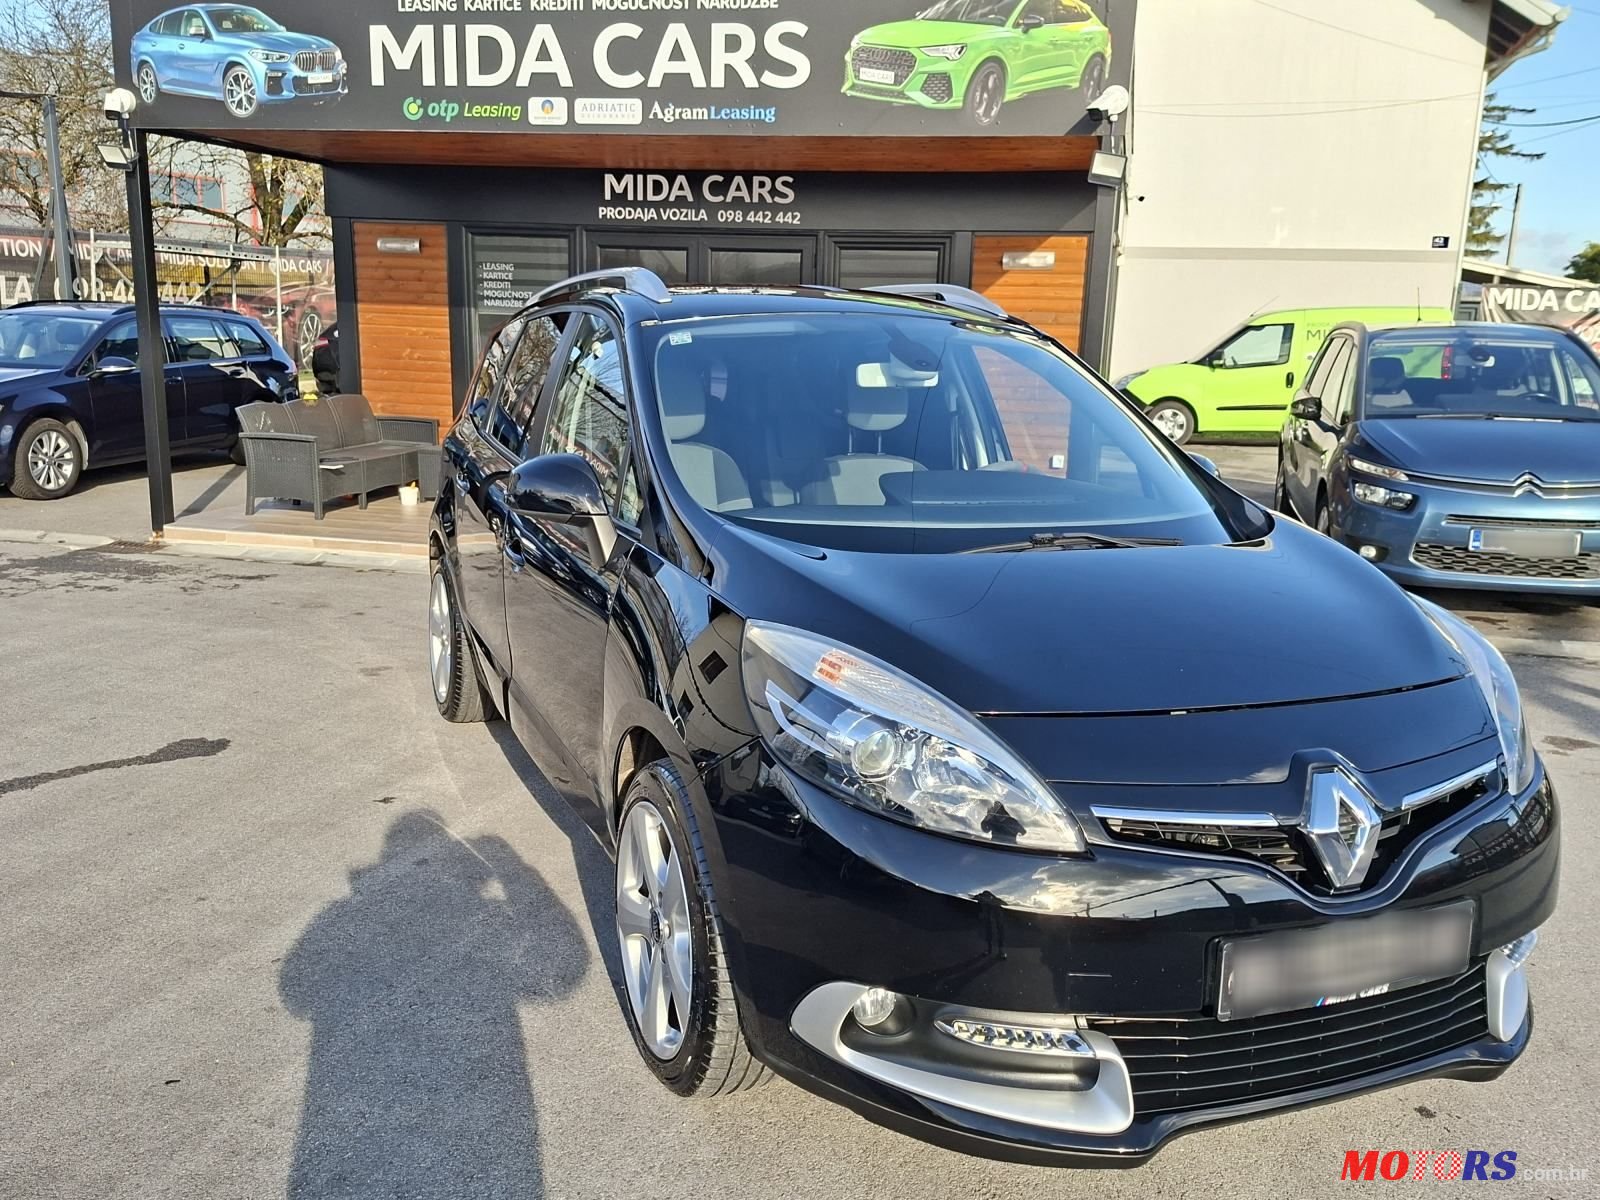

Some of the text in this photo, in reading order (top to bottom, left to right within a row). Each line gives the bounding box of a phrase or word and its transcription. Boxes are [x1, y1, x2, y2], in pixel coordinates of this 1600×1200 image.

[398, 0, 457, 12] LEASING
[464, 0, 521, 11] KARTICE
[530, 0, 584, 11] KREDITI
[368, 20, 812, 89] MIDA CARS
[427, 99, 522, 122] otp Leasing
[581, 103, 636, 113] ADRIATIC
[604, 173, 796, 204] MIDA CARS
[598, 206, 801, 225] PRODAJA VOZILA 098 442 442
[298, 259, 323, 273] CARS
[482, 262, 515, 271] LEASING
[483, 271, 513, 280] KARTICE
[1488, 287, 1560, 312] MIDA
